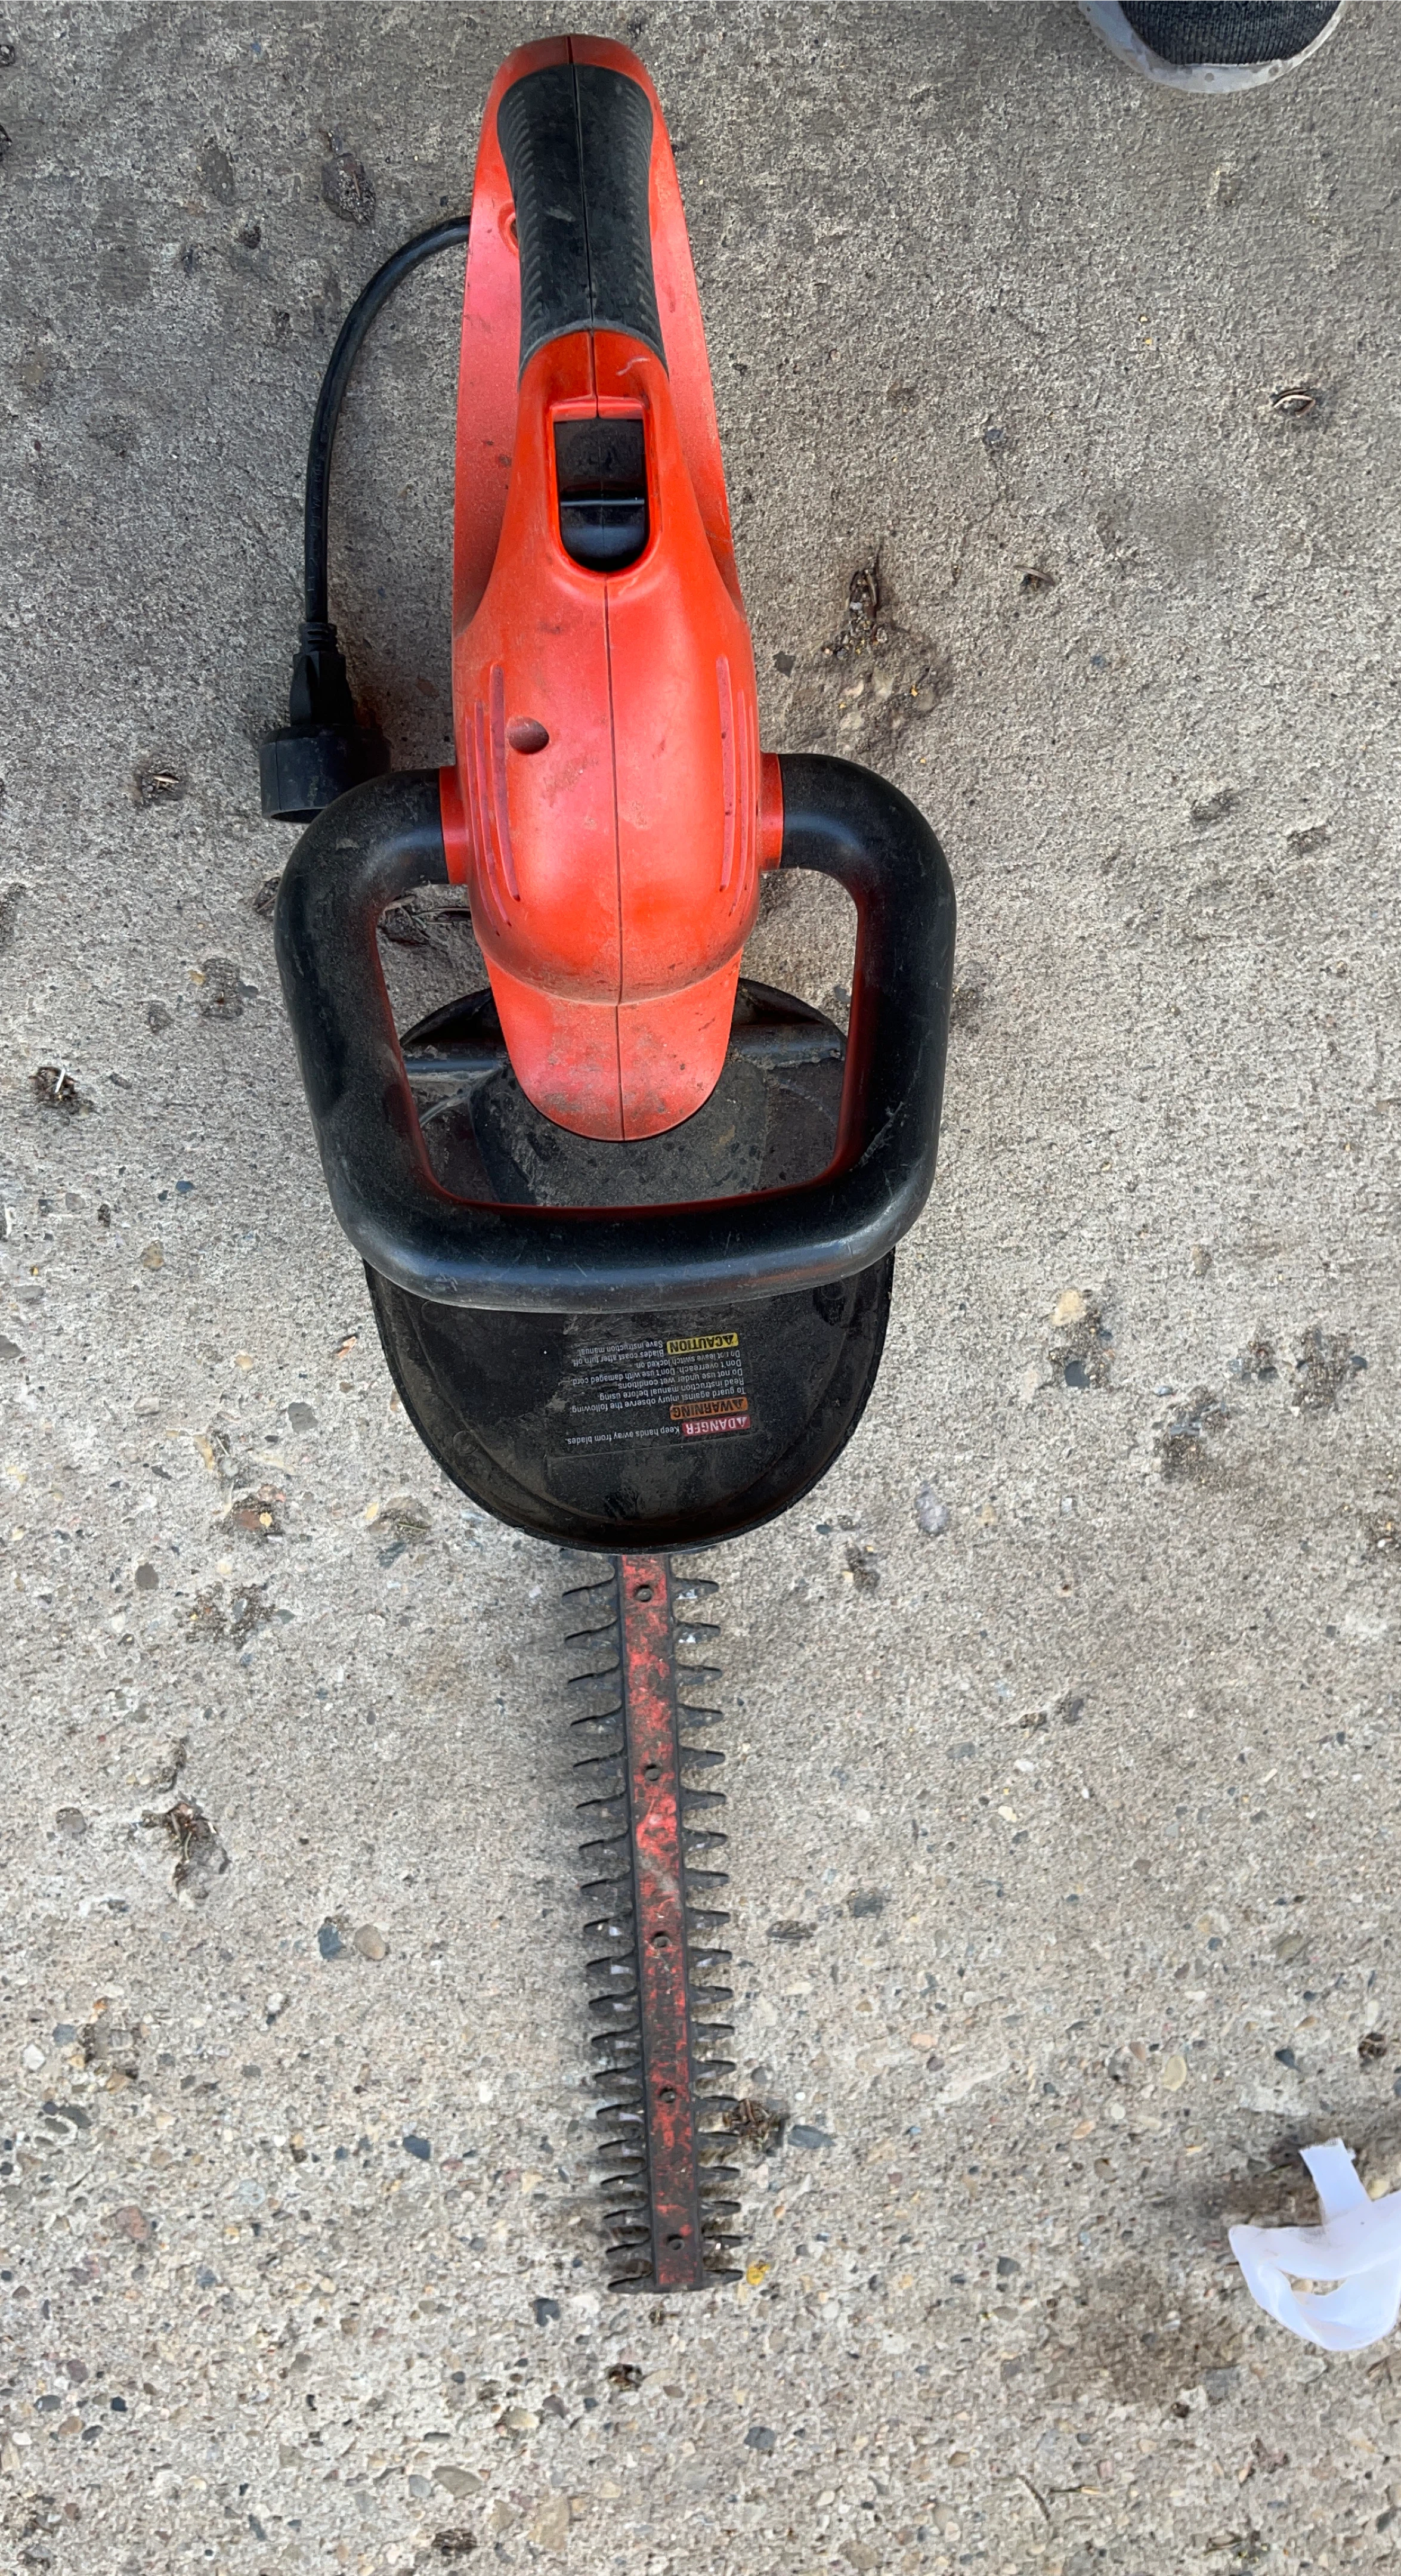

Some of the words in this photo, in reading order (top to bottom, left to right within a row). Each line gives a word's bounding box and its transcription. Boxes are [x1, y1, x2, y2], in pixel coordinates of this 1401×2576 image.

[607, 1343, 644, 1354] instruction
[669, 1336, 723, 1353] CAUTION
[640, 1349, 664, 1358] Blades
[600, 1355, 617, 1363] after
[672, 1356, 695, 1366] switch
[720, 1359, 741, 1368] Don't
[647, 1360, 670, 1368] locked
[656, 1368, 675, 1376] Don't
[590, 1374, 623, 1384] damaged
[678, 1374, 699, 1383] under
[725, 1377, 744, 1386] Read
[681, 1381, 722, 1392] instruction
[623, 1390, 648, 1398] before
[651, 1386, 679, 1397] manual
[681, 1391, 710, 1401] against
[713, 1386, 734, 1398] guard
[624, 1398, 655, 1407] observe
[658, 1395, 679, 1404] injury
[673, 1400, 734, 1418] WARNING
[686, 1418, 737, 1434] DANGER
[635, 1429, 658, 1438] hands
[567, 1436, 592, 1445] blades.
